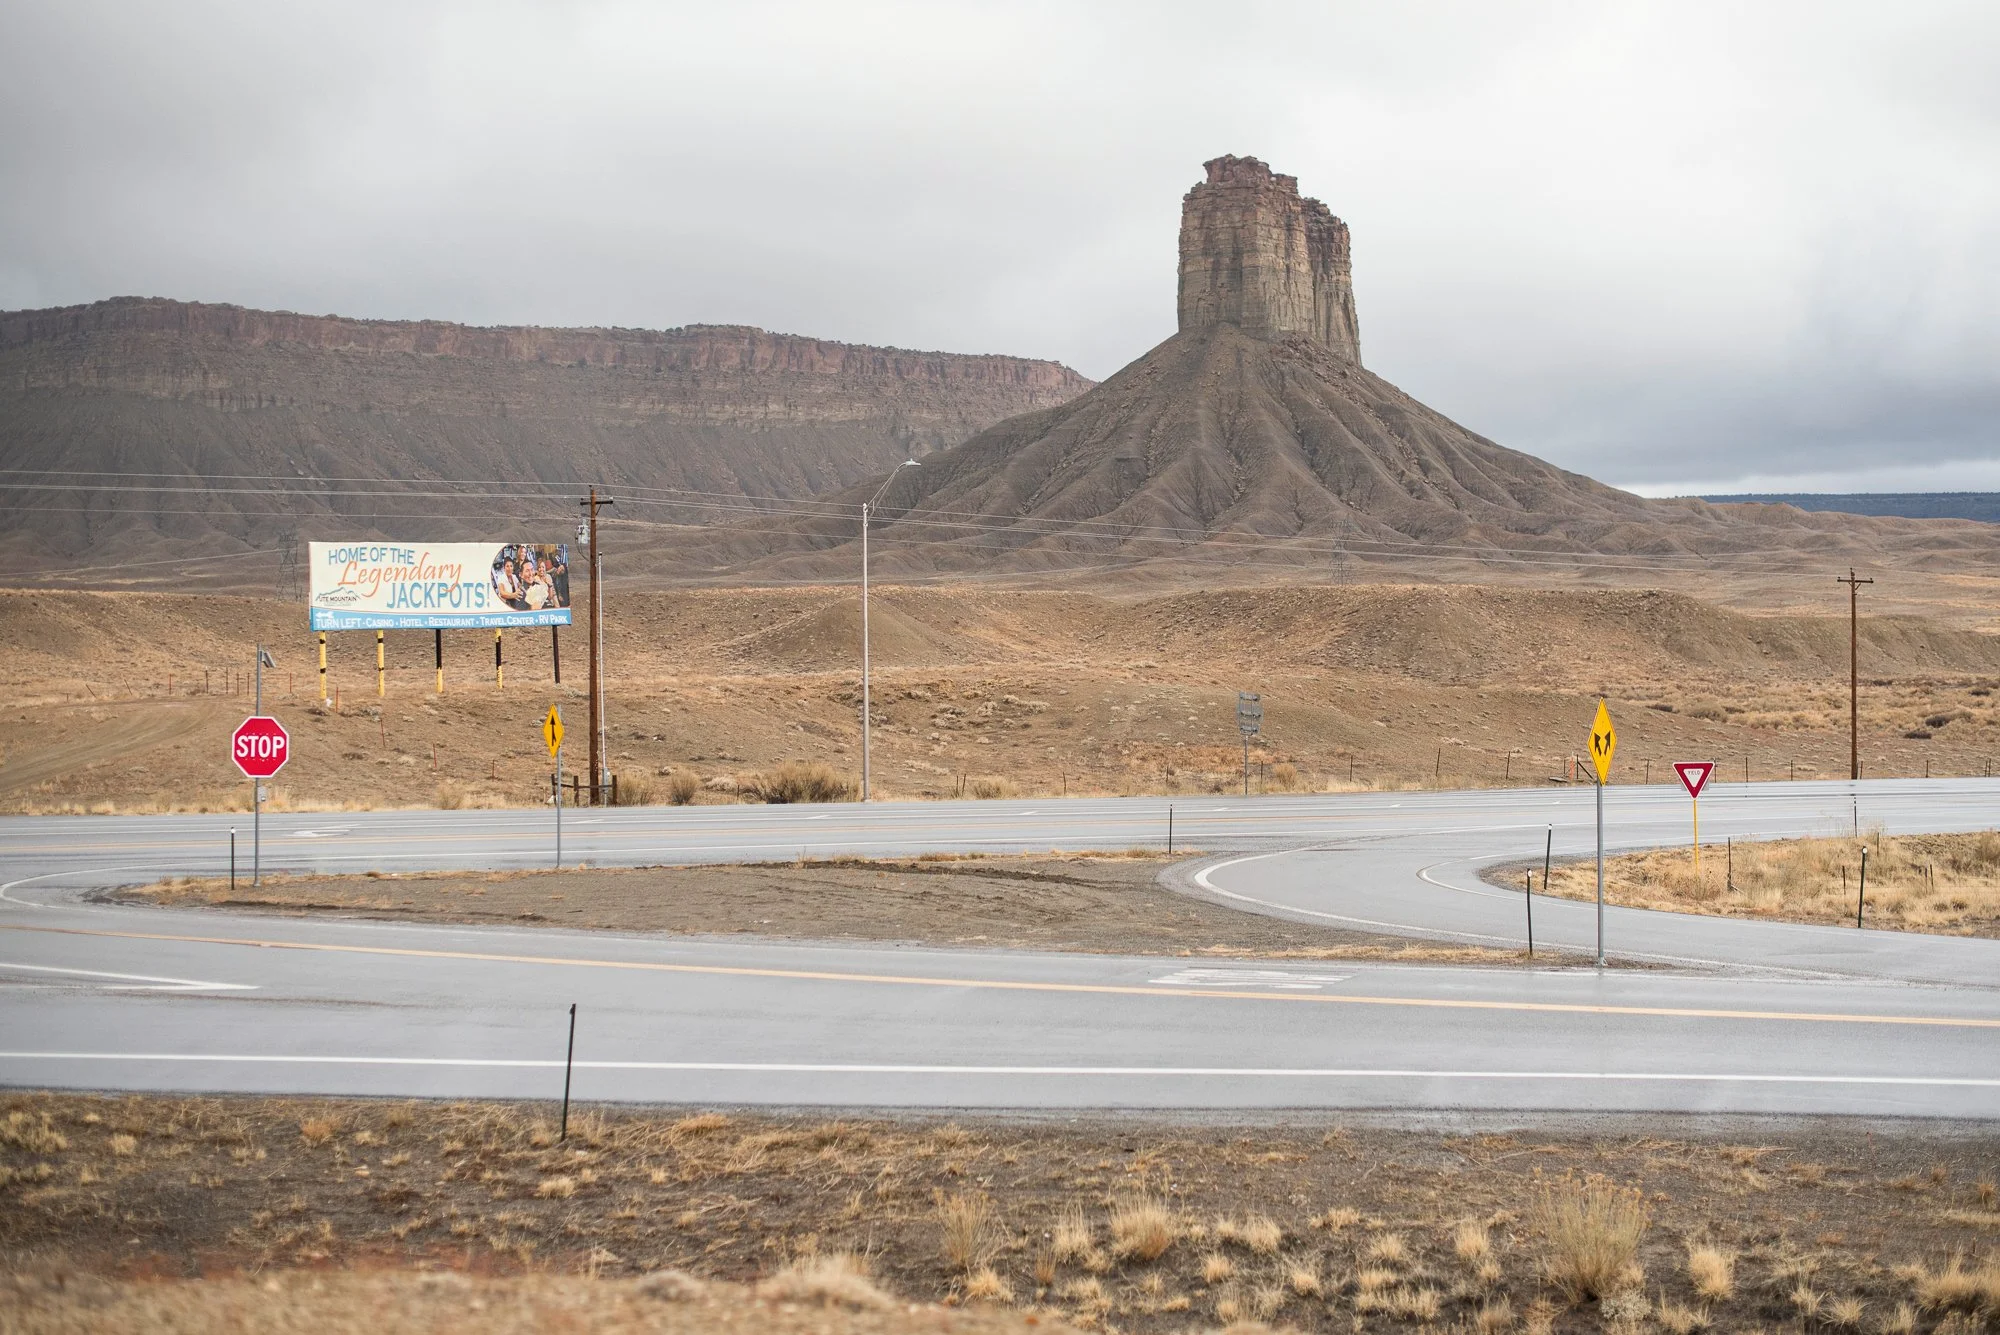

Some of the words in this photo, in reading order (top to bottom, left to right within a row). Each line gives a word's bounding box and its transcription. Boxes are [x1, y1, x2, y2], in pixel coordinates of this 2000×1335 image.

[328, 547, 367, 565] HOME
[370, 547, 387, 562] OF
[390, 547, 415, 565] THE
[337, 552, 462, 598] Legendary
[386, 582, 490, 608] JACKPOTS!
[316, 618, 340, 628] TURN
[341, 617, 361, 628] LEFT
[539, 614, 550, 624] RV
[236, 735, 285, 758] STOP
